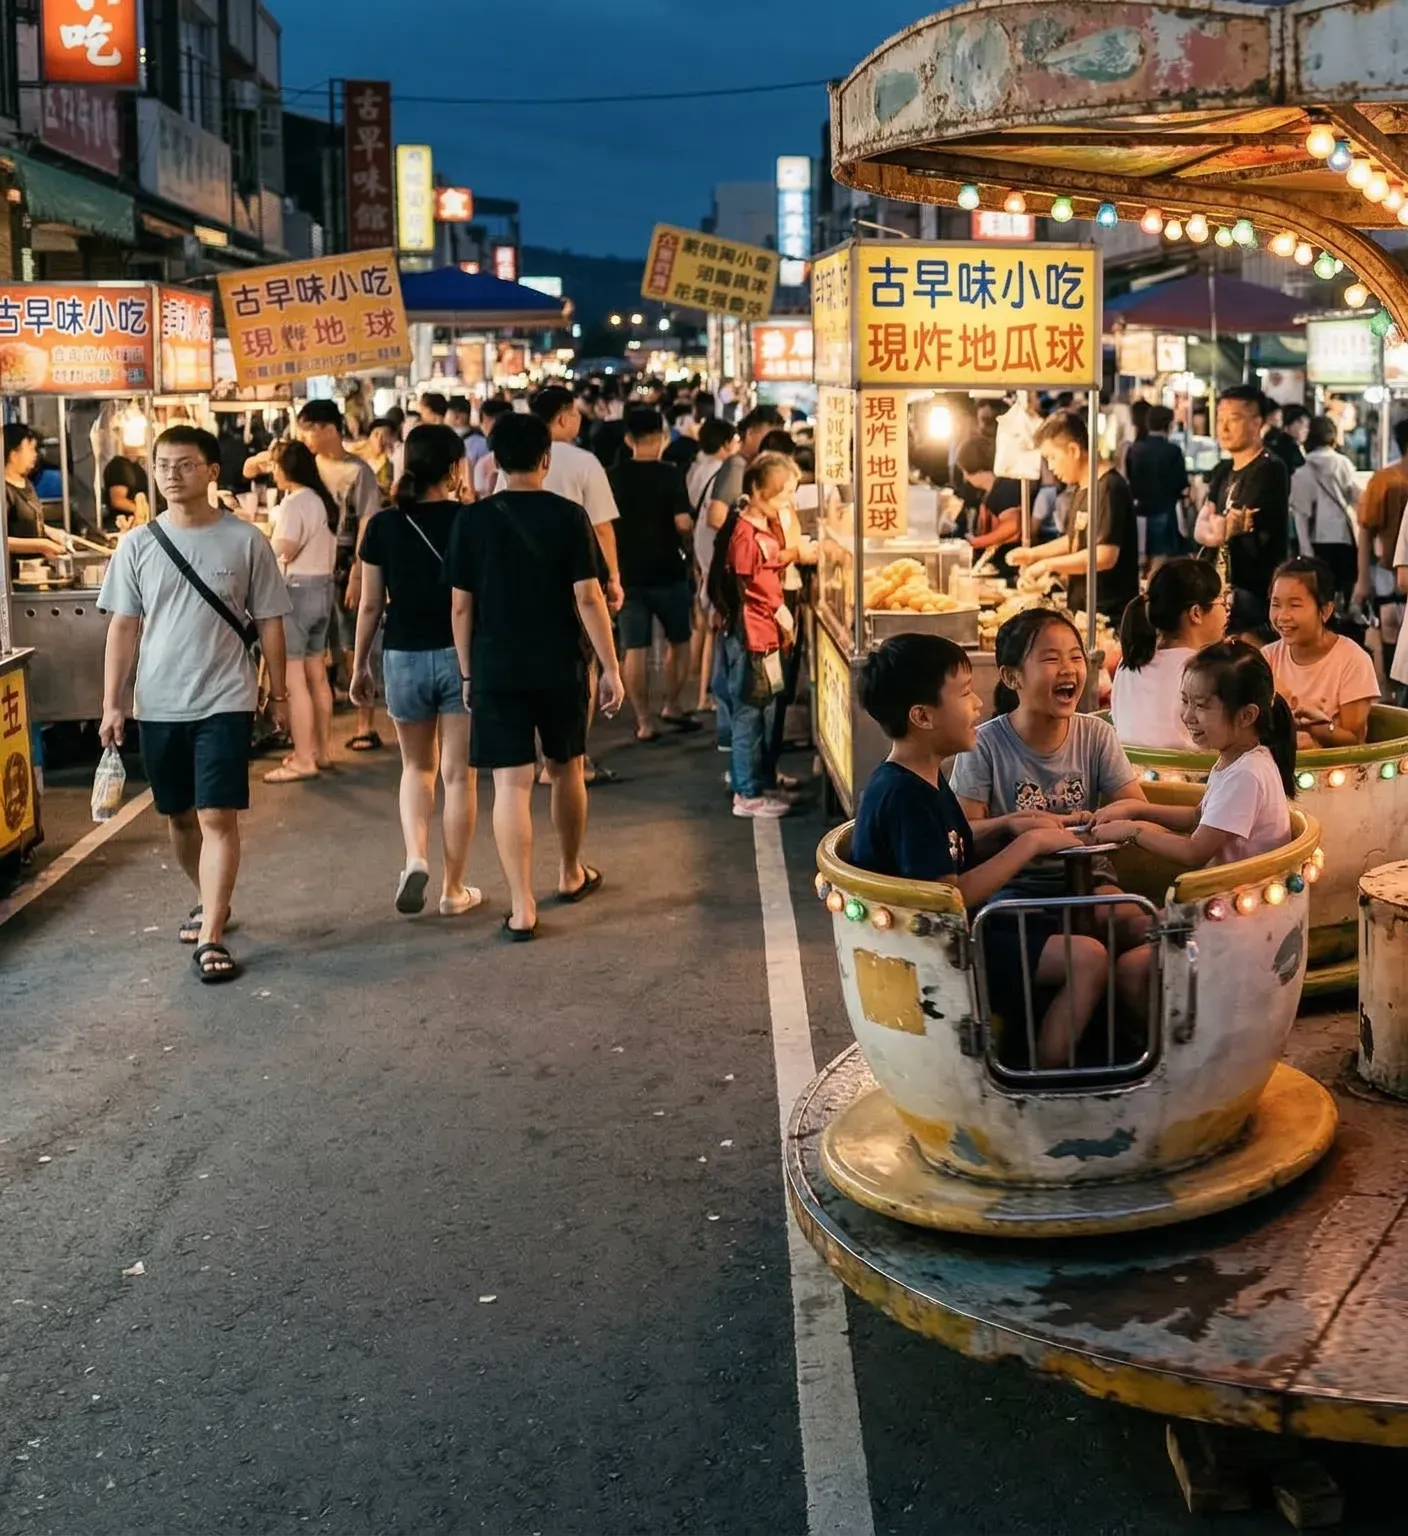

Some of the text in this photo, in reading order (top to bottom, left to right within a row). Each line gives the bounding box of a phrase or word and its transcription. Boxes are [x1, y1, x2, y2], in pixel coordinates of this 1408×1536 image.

[59, 0, 122, 66] 吃
[231, 265, 393, 316] 古早味小吃
[868, 256, 1085, 310] 古早味小吃
[0, 298, 147, 335] 古早味小吃
[868, 321, 1085, 372] 現炸地瓜球
[865, 396, 899, 531] 現炸地瓜球
